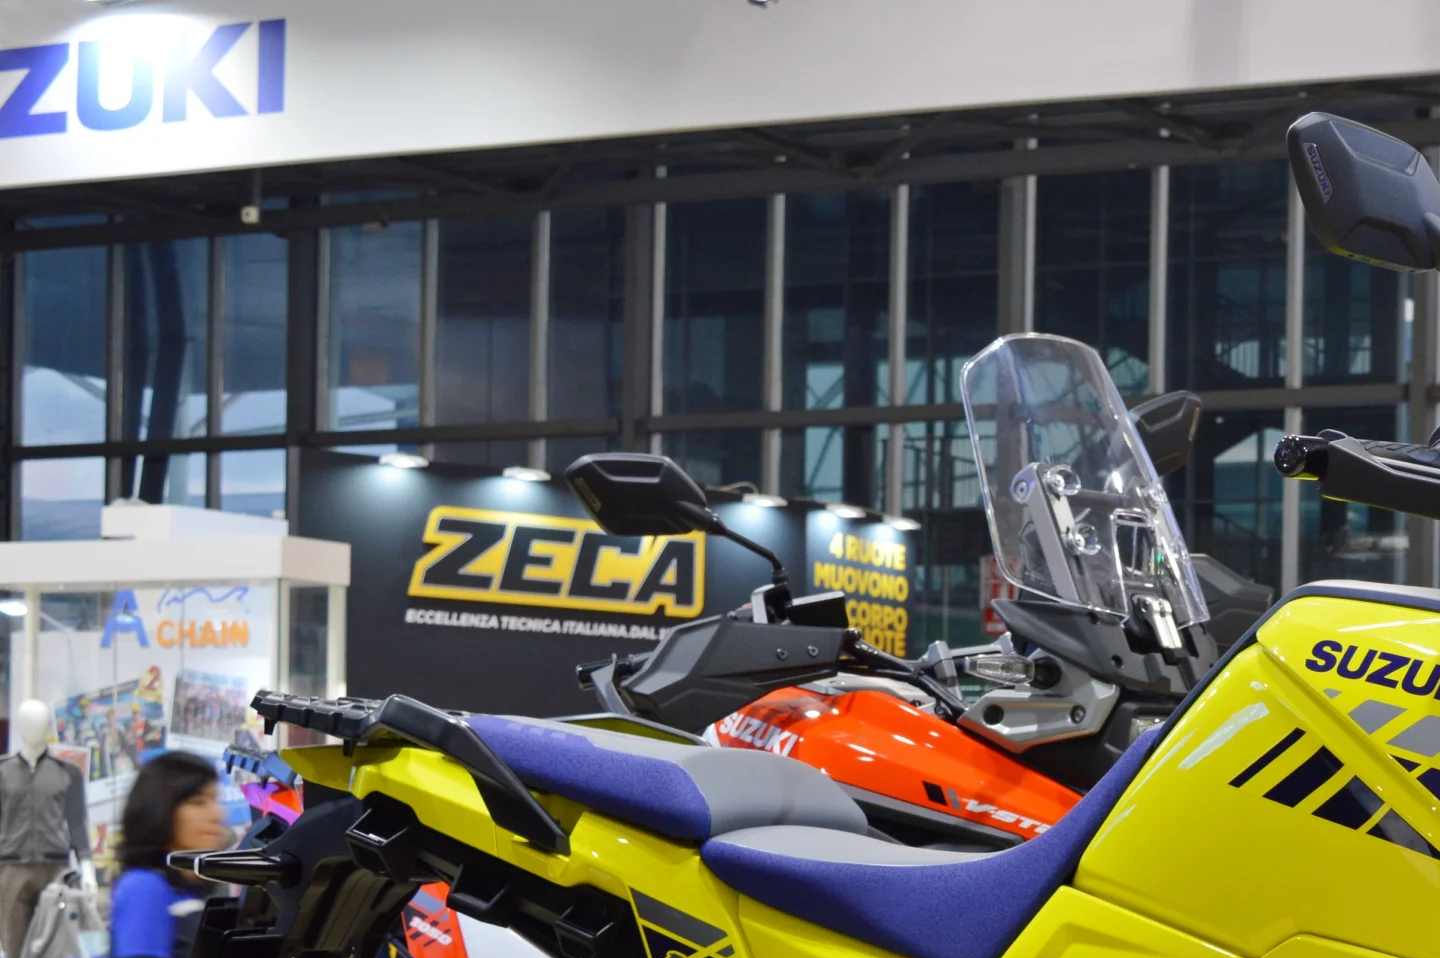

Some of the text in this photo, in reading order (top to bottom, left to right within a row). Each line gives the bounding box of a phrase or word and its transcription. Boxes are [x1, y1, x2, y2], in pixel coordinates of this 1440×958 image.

[1306, 145, 1331, 196] SUZUKI
[420, 516, 697, 608] ZECA
[828, 531, 907, 570] 4 RUOTE
[814, 562, 909, 602] MUOVONO
[156, 619, 248, 648] CHAIN
[405, 608, 499, 629] ECCELLENZA
[500, 616, 562, 634] TECNICA
[846, 599, 909, 632] CORPO
[849, 626, 906, 657] UOTE
[719, 711, 798, 757] SUZUKI
[409, 915, 452, 946] 1050
